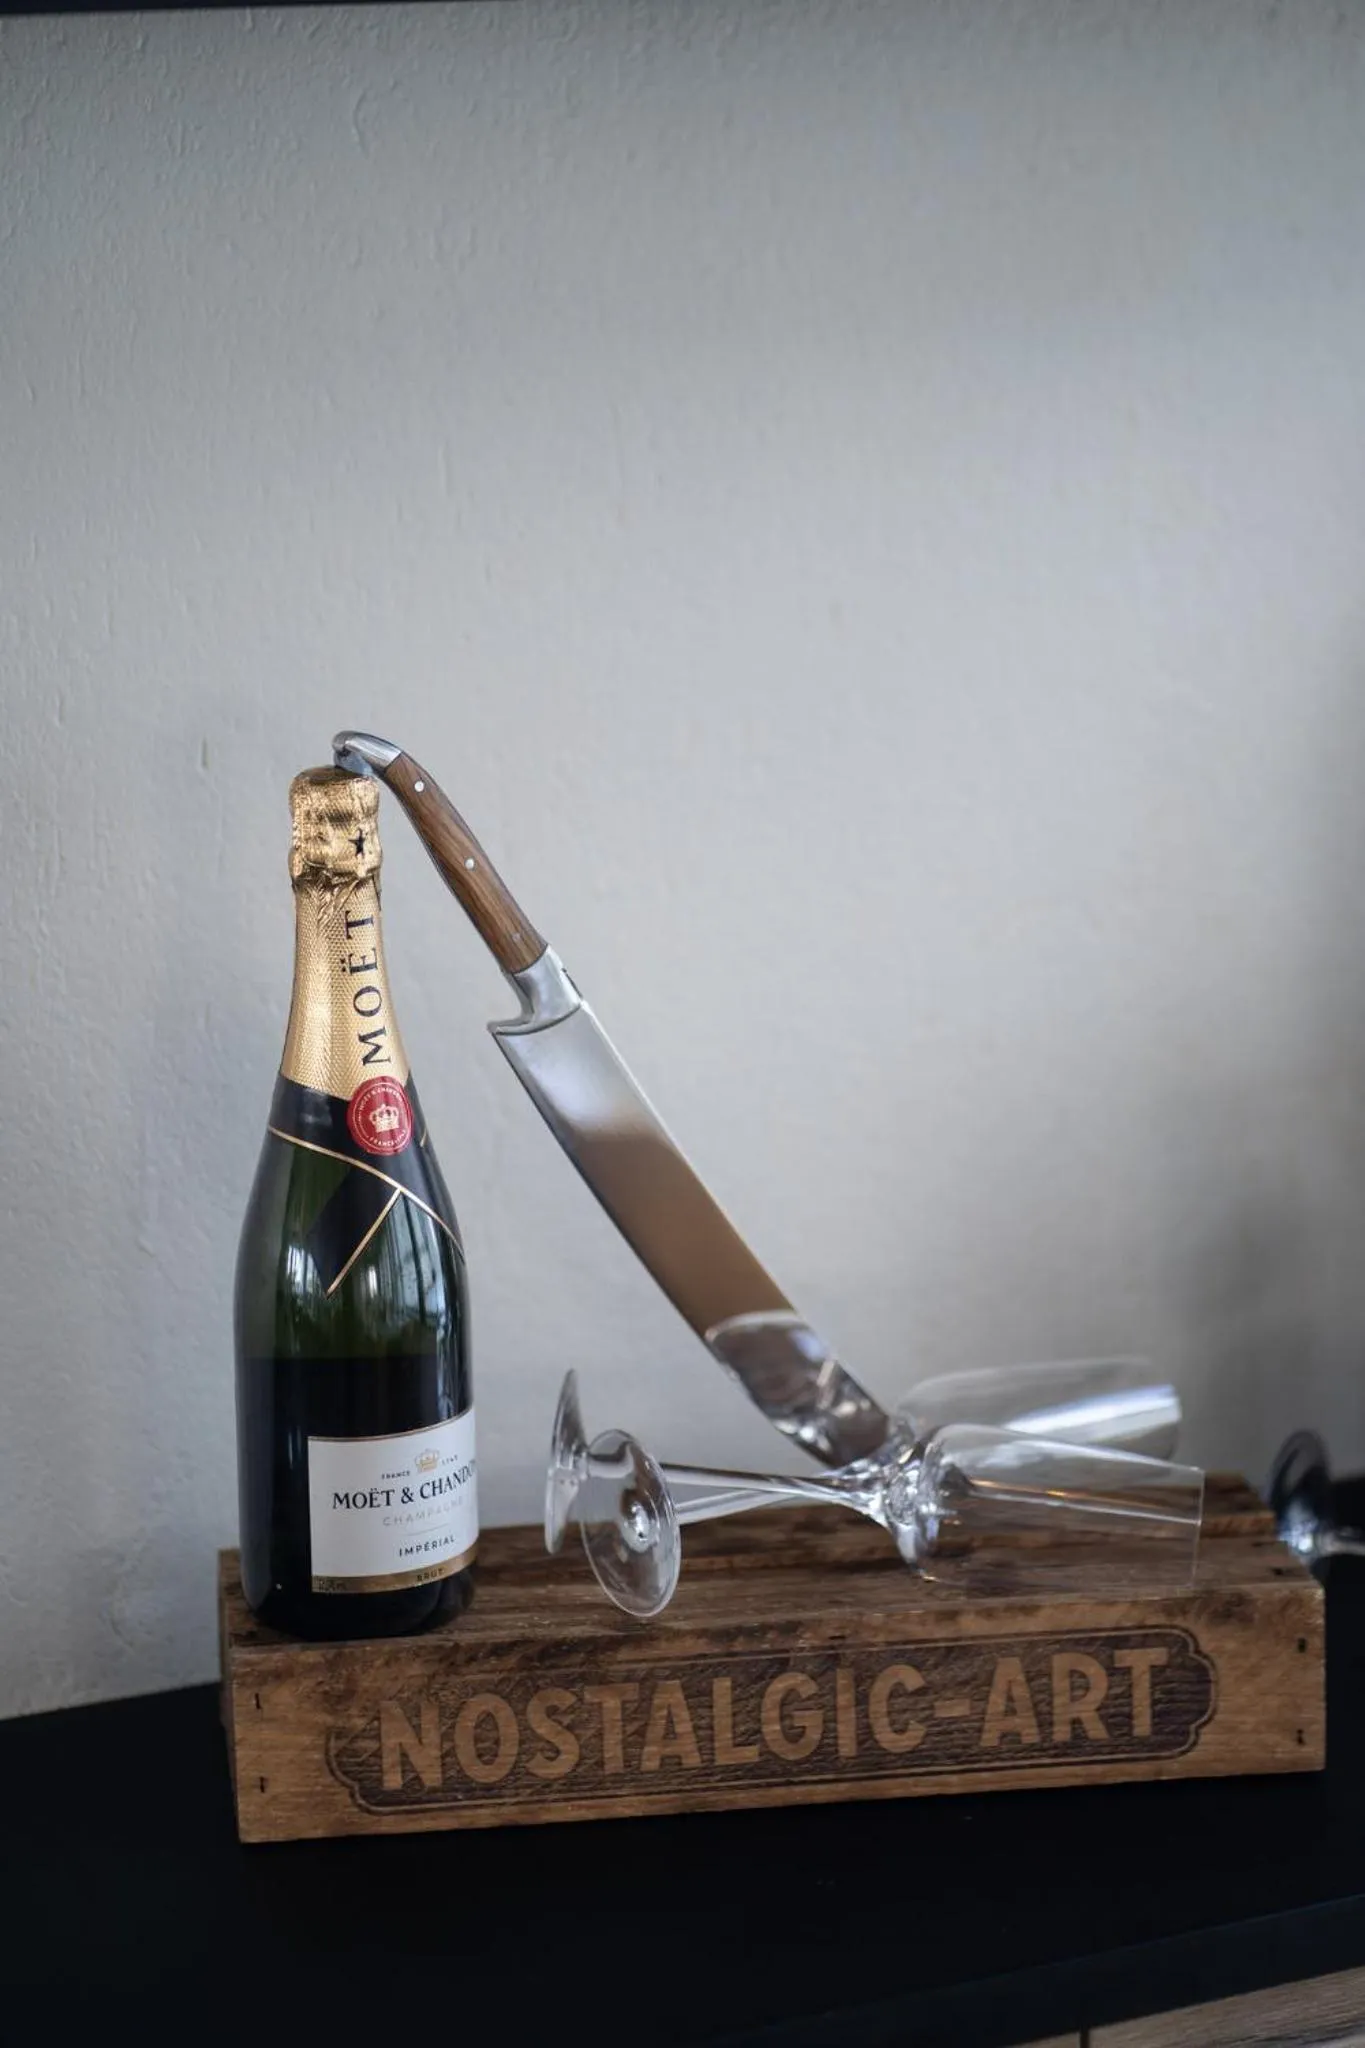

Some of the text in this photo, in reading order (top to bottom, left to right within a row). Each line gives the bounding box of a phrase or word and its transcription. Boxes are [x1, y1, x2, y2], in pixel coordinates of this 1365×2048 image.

[340, 910, 392, 1067] MOËT
[332, 1487, 395, 1510] MOËT
[400, 1486, 415, 1505] &
[377, 1646, 1169, 1791] NOSTALGIC-ART
